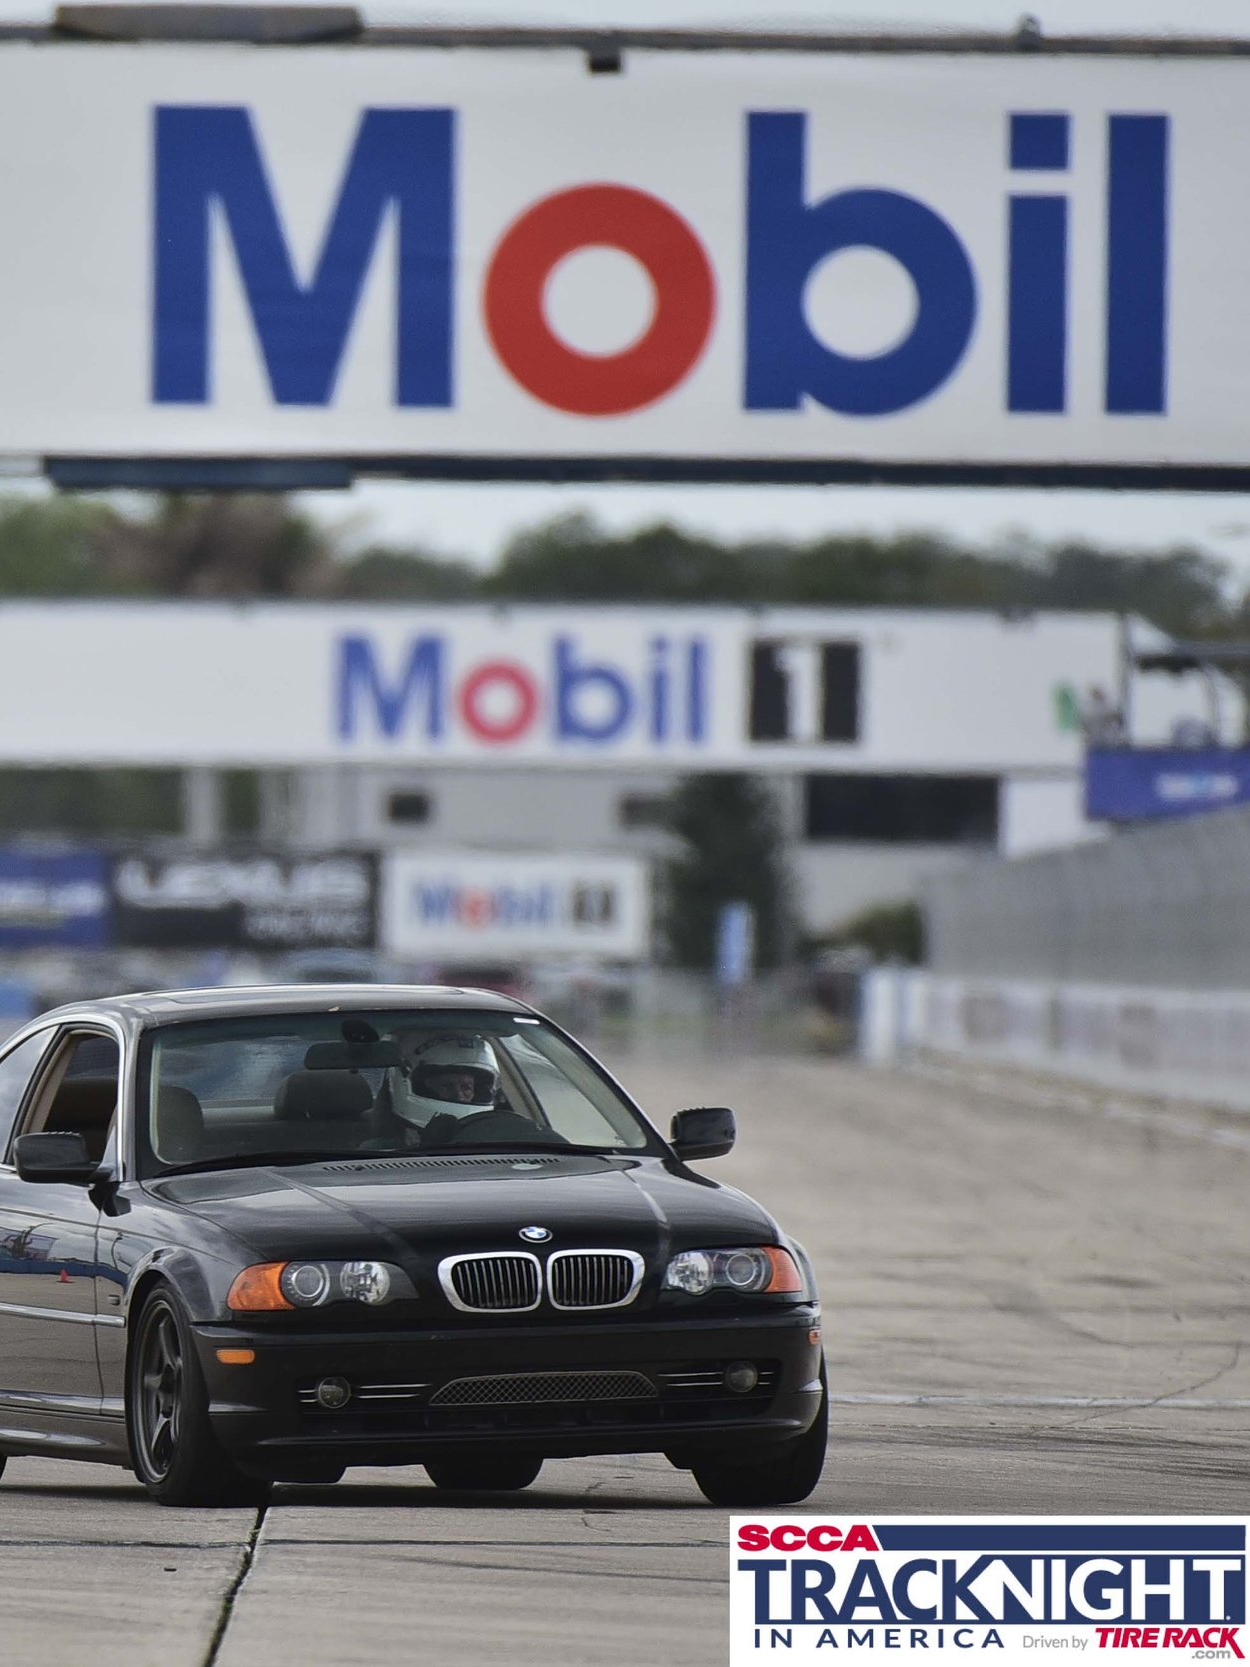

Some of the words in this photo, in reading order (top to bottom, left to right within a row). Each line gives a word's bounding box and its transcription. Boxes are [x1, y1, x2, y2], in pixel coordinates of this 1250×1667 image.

[151, 105, 1169, 417] Mobil
[336, 633, 708, 744] Mobil
[117, 860, 371, 908] LEXUS
[415, 882, 553, 932] Mobil
